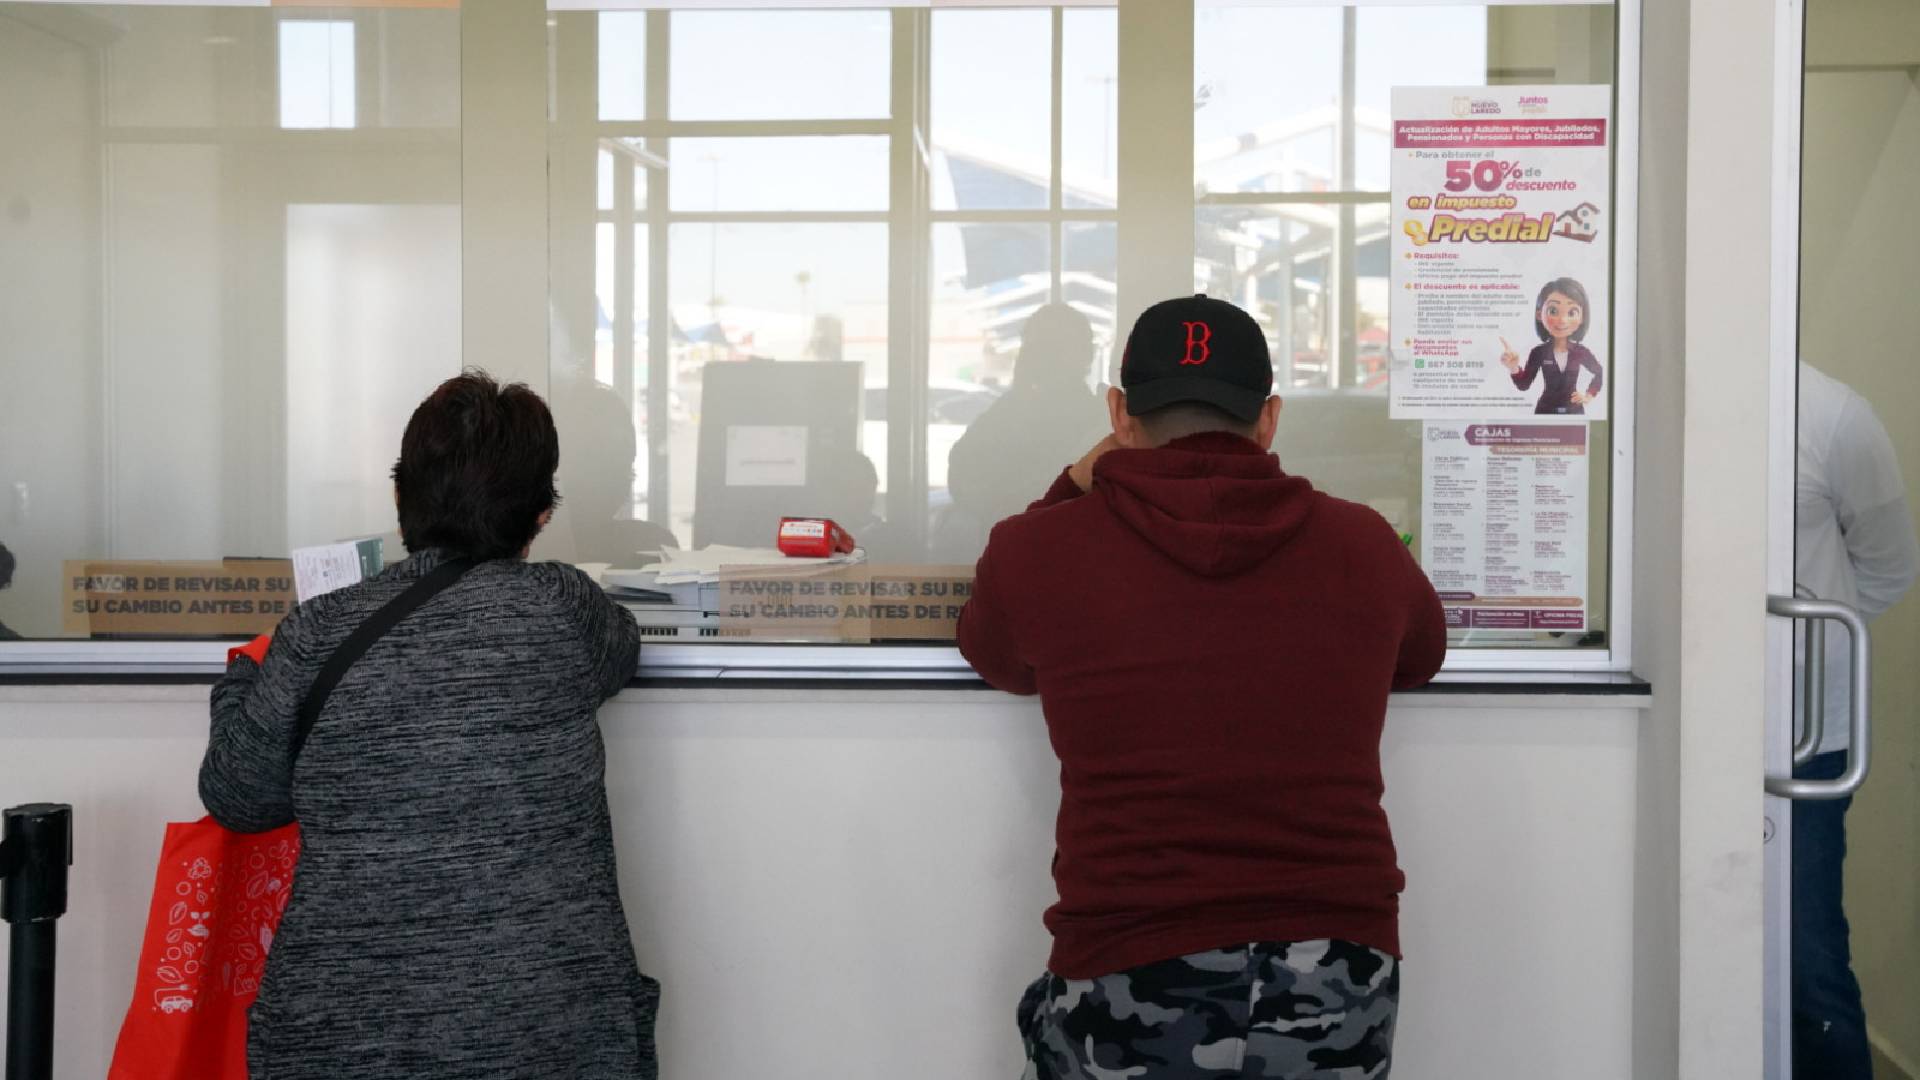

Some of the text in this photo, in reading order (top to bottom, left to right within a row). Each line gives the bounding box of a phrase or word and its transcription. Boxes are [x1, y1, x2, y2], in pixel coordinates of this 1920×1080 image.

[1398, 124, 1600, 134] Actualización de Adultos Mayores, Jubilados,
[1407, 133, 1464, 142] Pensionados
[1465, 134, 1470, 142] y
[1472, 133, 1513, 141] Personas
[1534, 132, 1594, 142] Discapacidad
[1416, 151, 1438, 159] Para
[1484, 150, 1494, 158] el
[1444, 160, 1542, 192] 50% de
[1506, 179, 1577, 191] descuento
[1408, 194, 1517, 212] en impuesto
[1428, 212, 1556, 242] Predial
[1414, 252, 1460, 260] Requisitos:
[1180, 321, 1212, 365] B
[1474, 428, 1512, 438] CAJAS
[72, 576, 290, 591] FAVOR DE REVISAR SU
[730, 581, 794, 596] FAVOR
[798, 582, 824, 596] DE
[829, 582, 915, 596] REVISAR
[920, 582, 948, 596] SU
[72, 600, 284, 614] SU CAMBIO ANTES DE
[730, 604, 755, 618] SU
[760, 604, 838, 618] CAMBIO
[844, 604, 910, 618] ANTES
[914, 605, 941, 618] DE
